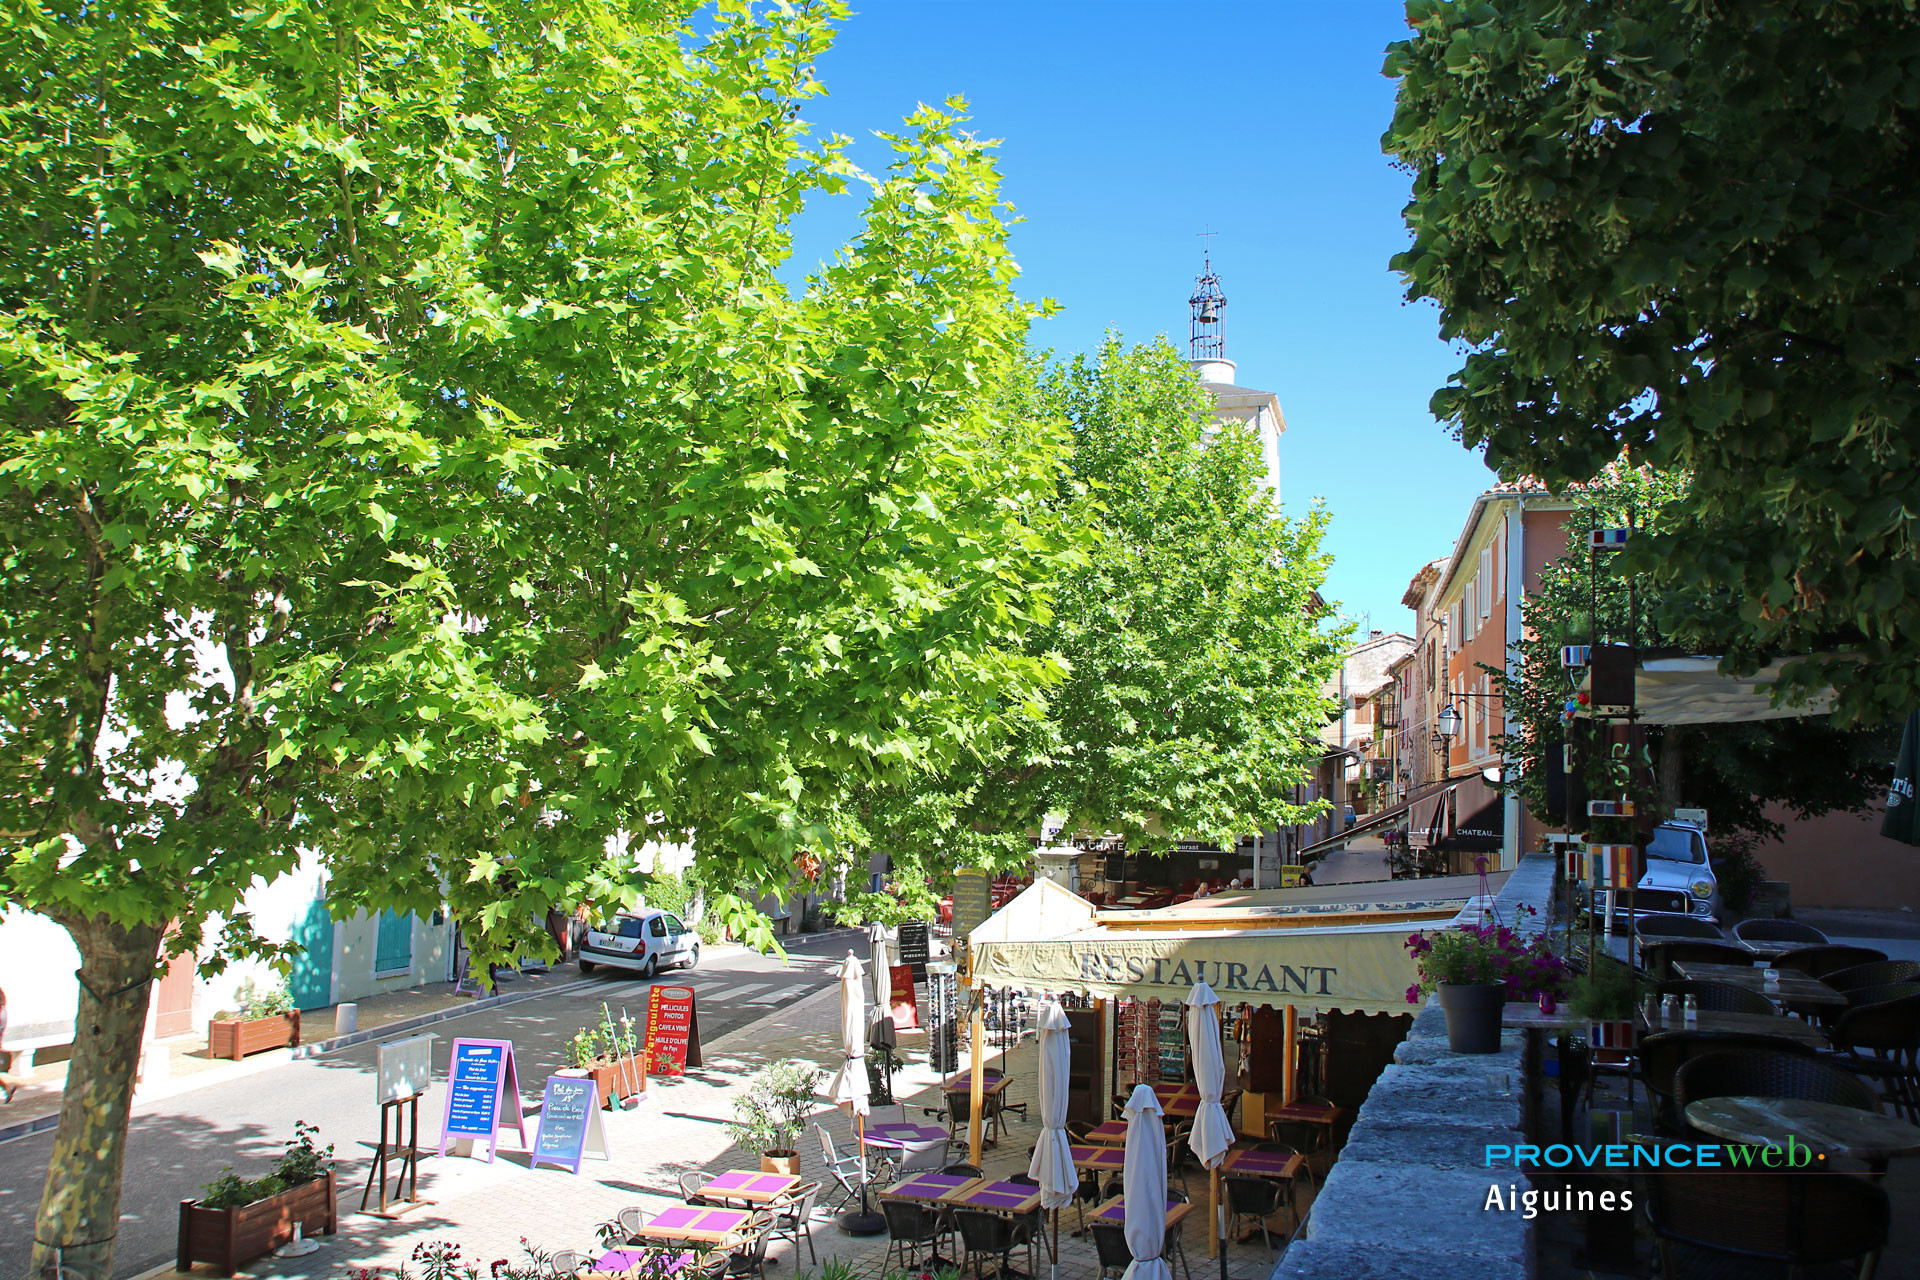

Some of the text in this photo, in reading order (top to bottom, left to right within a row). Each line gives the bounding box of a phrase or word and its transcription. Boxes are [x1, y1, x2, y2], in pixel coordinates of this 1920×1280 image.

[1080, 952, 1338, 995] RESTAURANT
[646, 987, 660, 1054] Farigoulette
[660, 1004, 689, 1012] PELLICULES
[663, 1012, 684, 1020] PHOTOS
